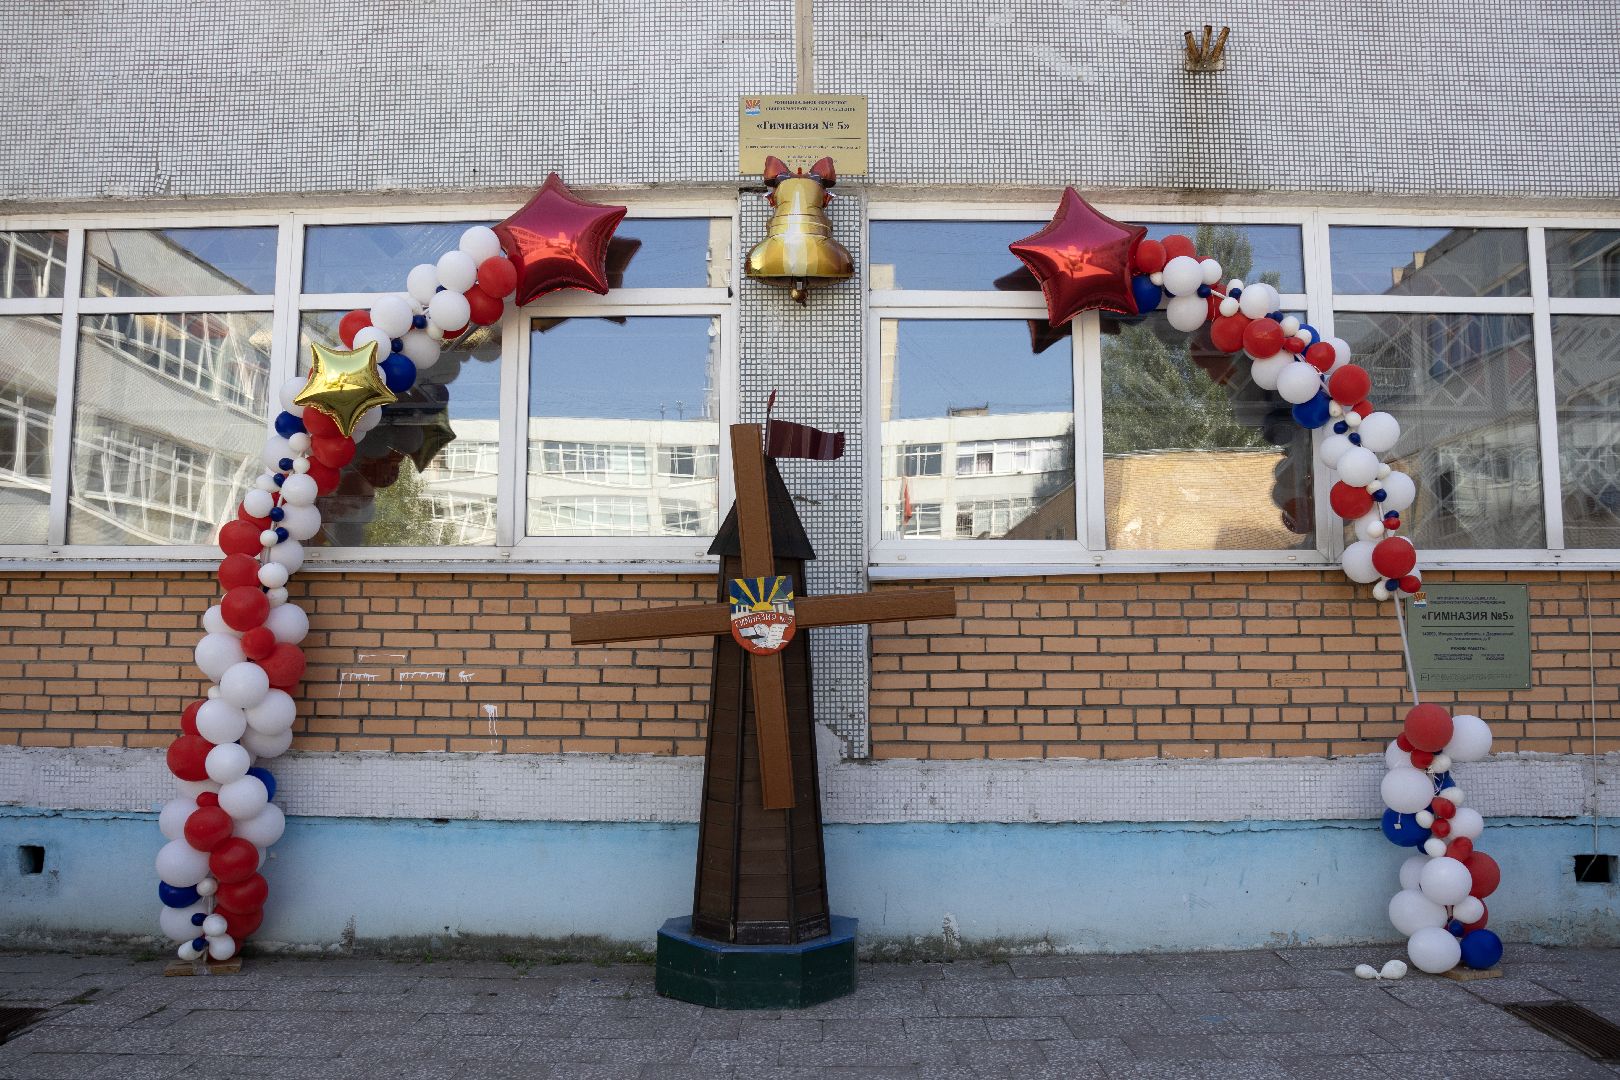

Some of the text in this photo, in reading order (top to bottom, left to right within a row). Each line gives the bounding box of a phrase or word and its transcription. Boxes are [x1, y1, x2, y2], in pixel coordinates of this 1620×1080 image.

[756, 121, 850, 130] «Гимназия № 5»
[1421, 611, 1514, 621] «ГИМНАЗИЯ №5»
